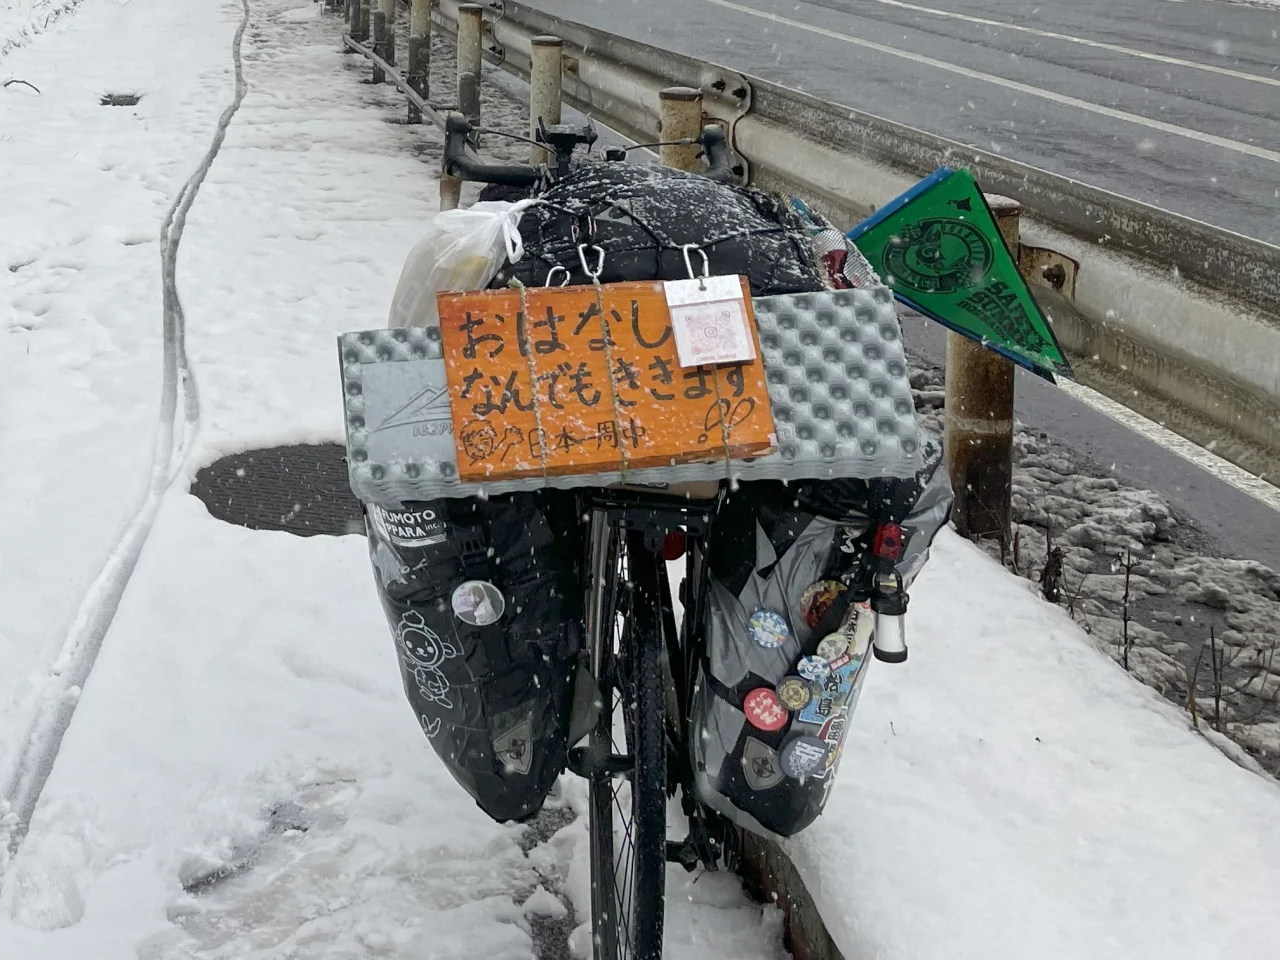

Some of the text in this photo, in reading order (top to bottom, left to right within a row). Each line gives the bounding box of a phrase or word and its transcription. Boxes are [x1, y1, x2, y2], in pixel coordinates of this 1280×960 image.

[459, 299, 671, 359] おはなし
[461, 355, 745, 416] なんでもききます
[528, 418, 646, 459] 日本一周中
[381, 509, 436, 525] FUMOTO
